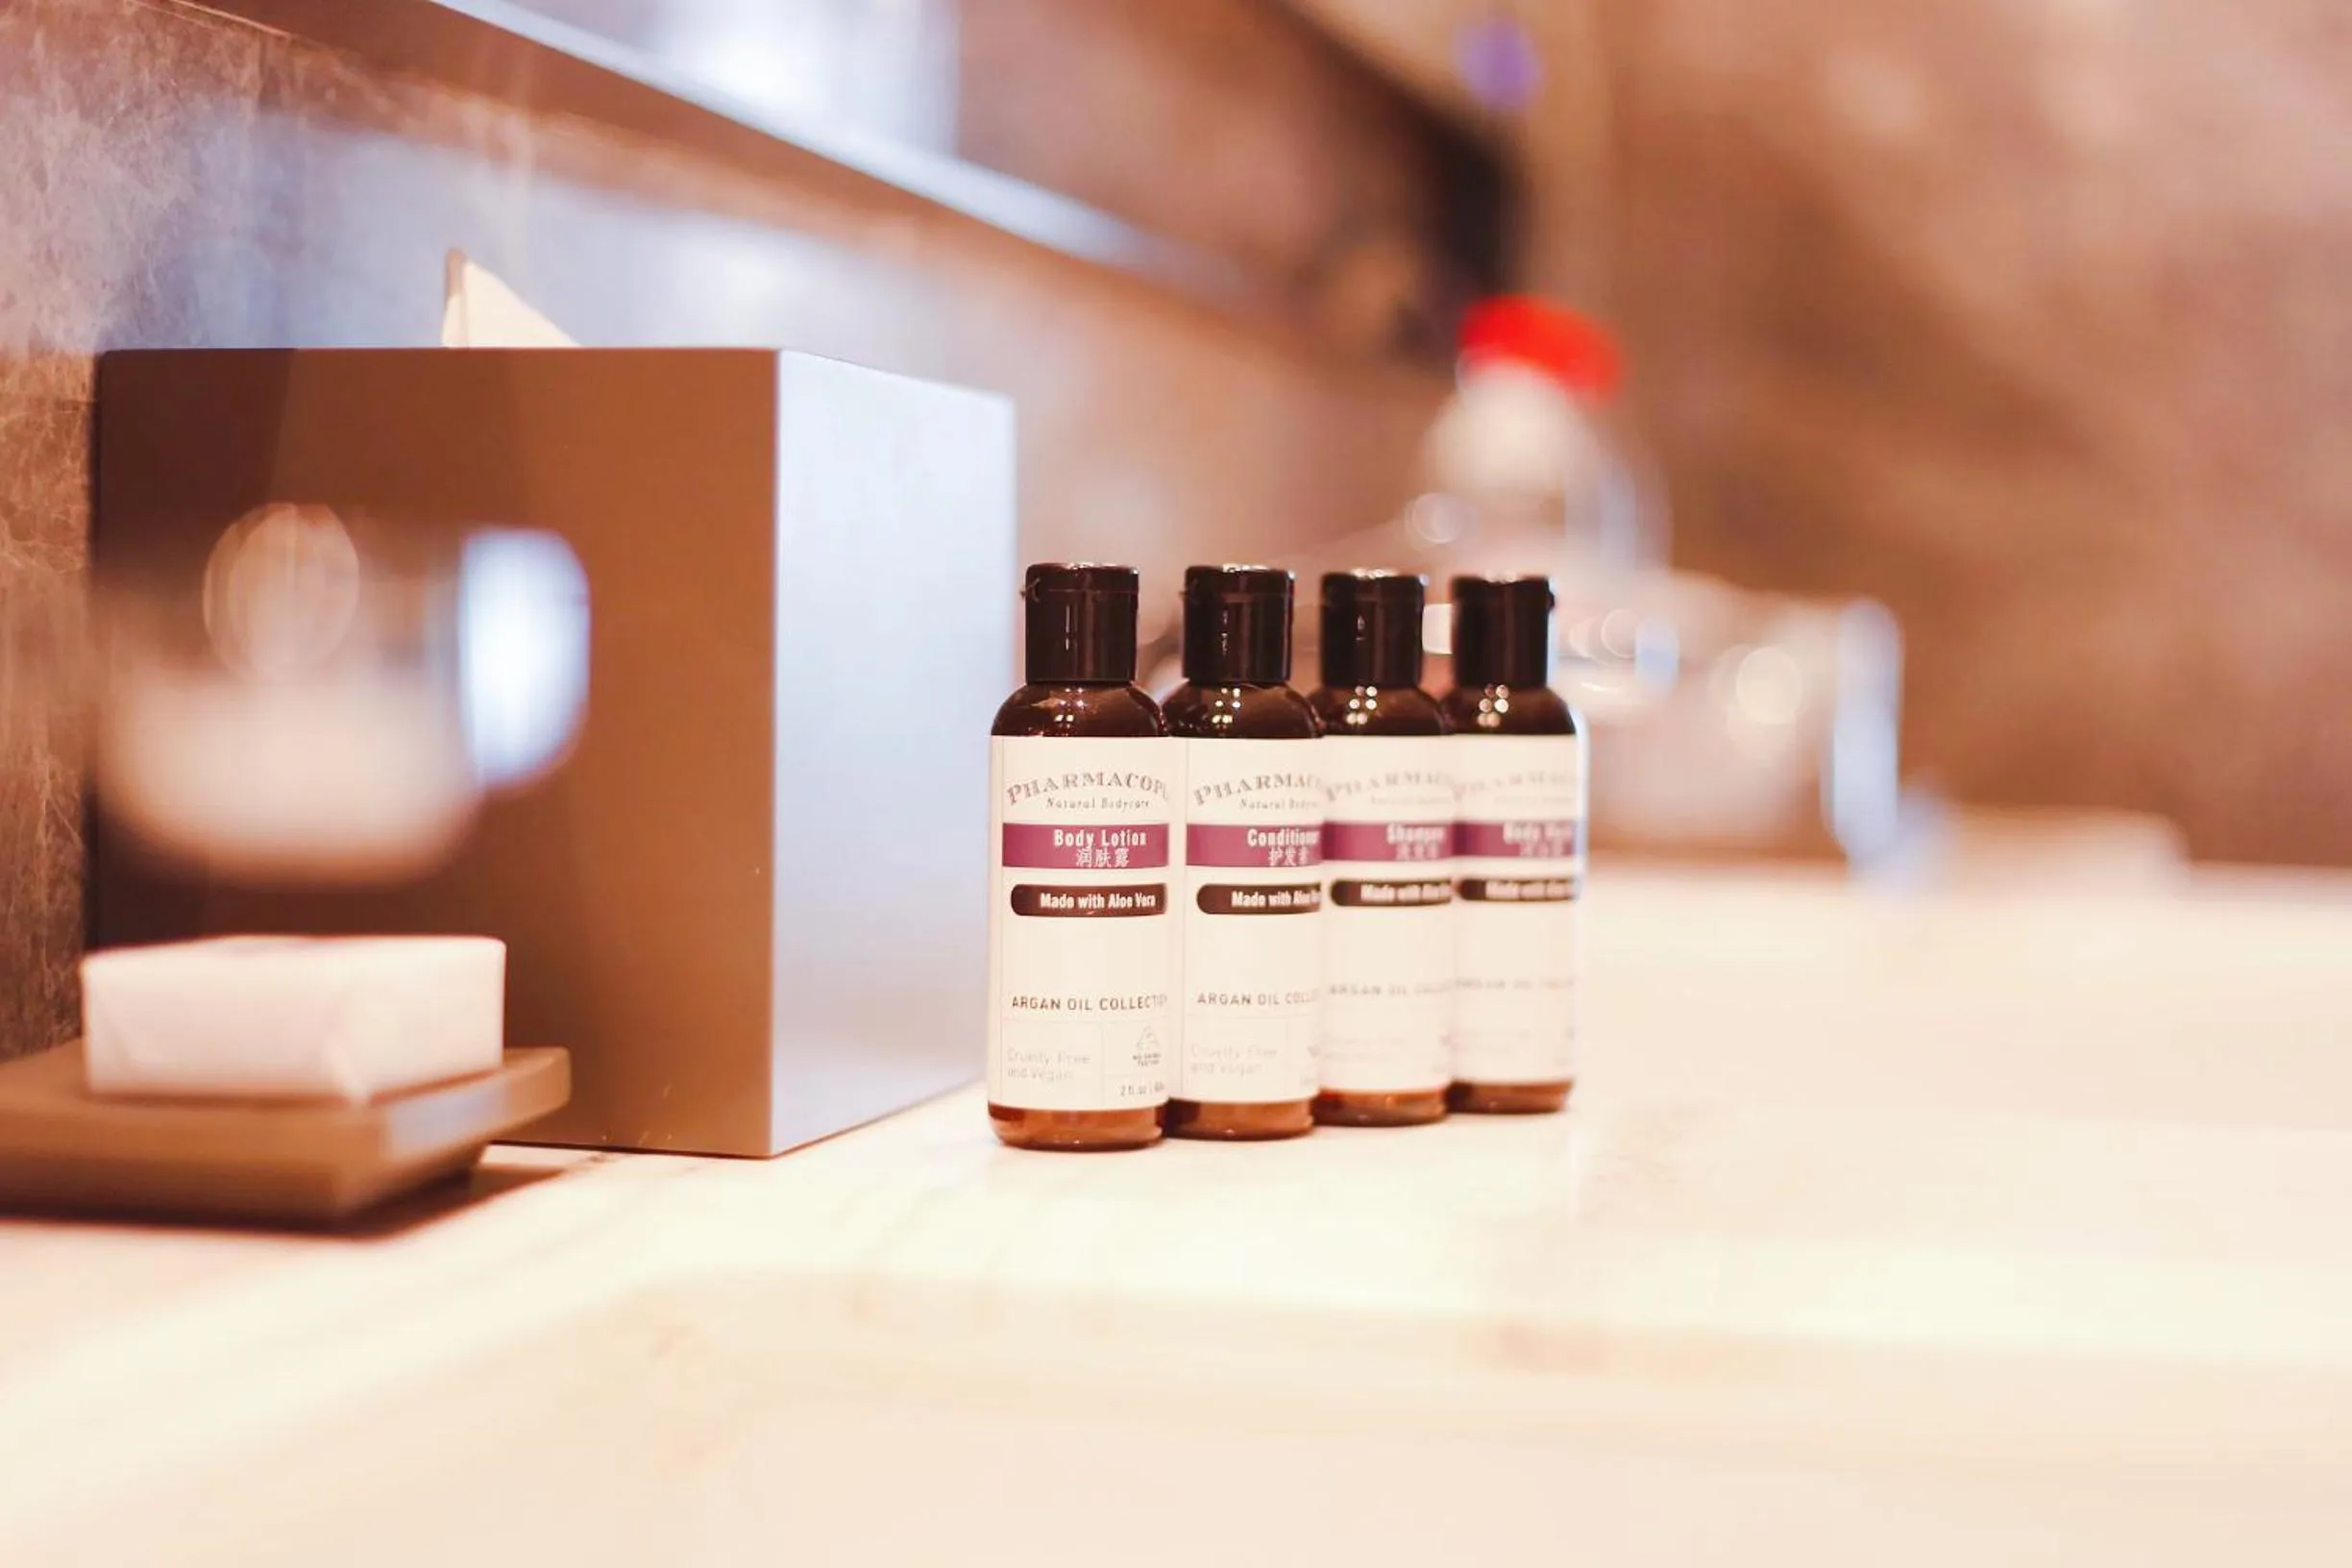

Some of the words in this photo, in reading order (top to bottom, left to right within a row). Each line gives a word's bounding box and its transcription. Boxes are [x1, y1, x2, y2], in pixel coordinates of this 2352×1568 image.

[1046, 796, 1095, 809] Natural
[1054, 829, 1094, 849] Body
[1102, 828, 1147, 846] Lotion
[1076, 846, 1131, 869] 润肤露
[1040, 893, 1075, 909] Made
[1078, 892, 1106, 908] with
[1109, 892, 1134, 908] Aloe
[1135, 892, 1157, 906] Vera
[1231, 891, 1266, 907] Made
[1269, 891, 1292, 907] with
[1012, 995, 1061, 1010] ARGAN
[1067, 996, 1092, 1011] OIL
[1196, 992, 1252, 1006] ARGAN
[1257, 992, 1280, 1006] OIL
